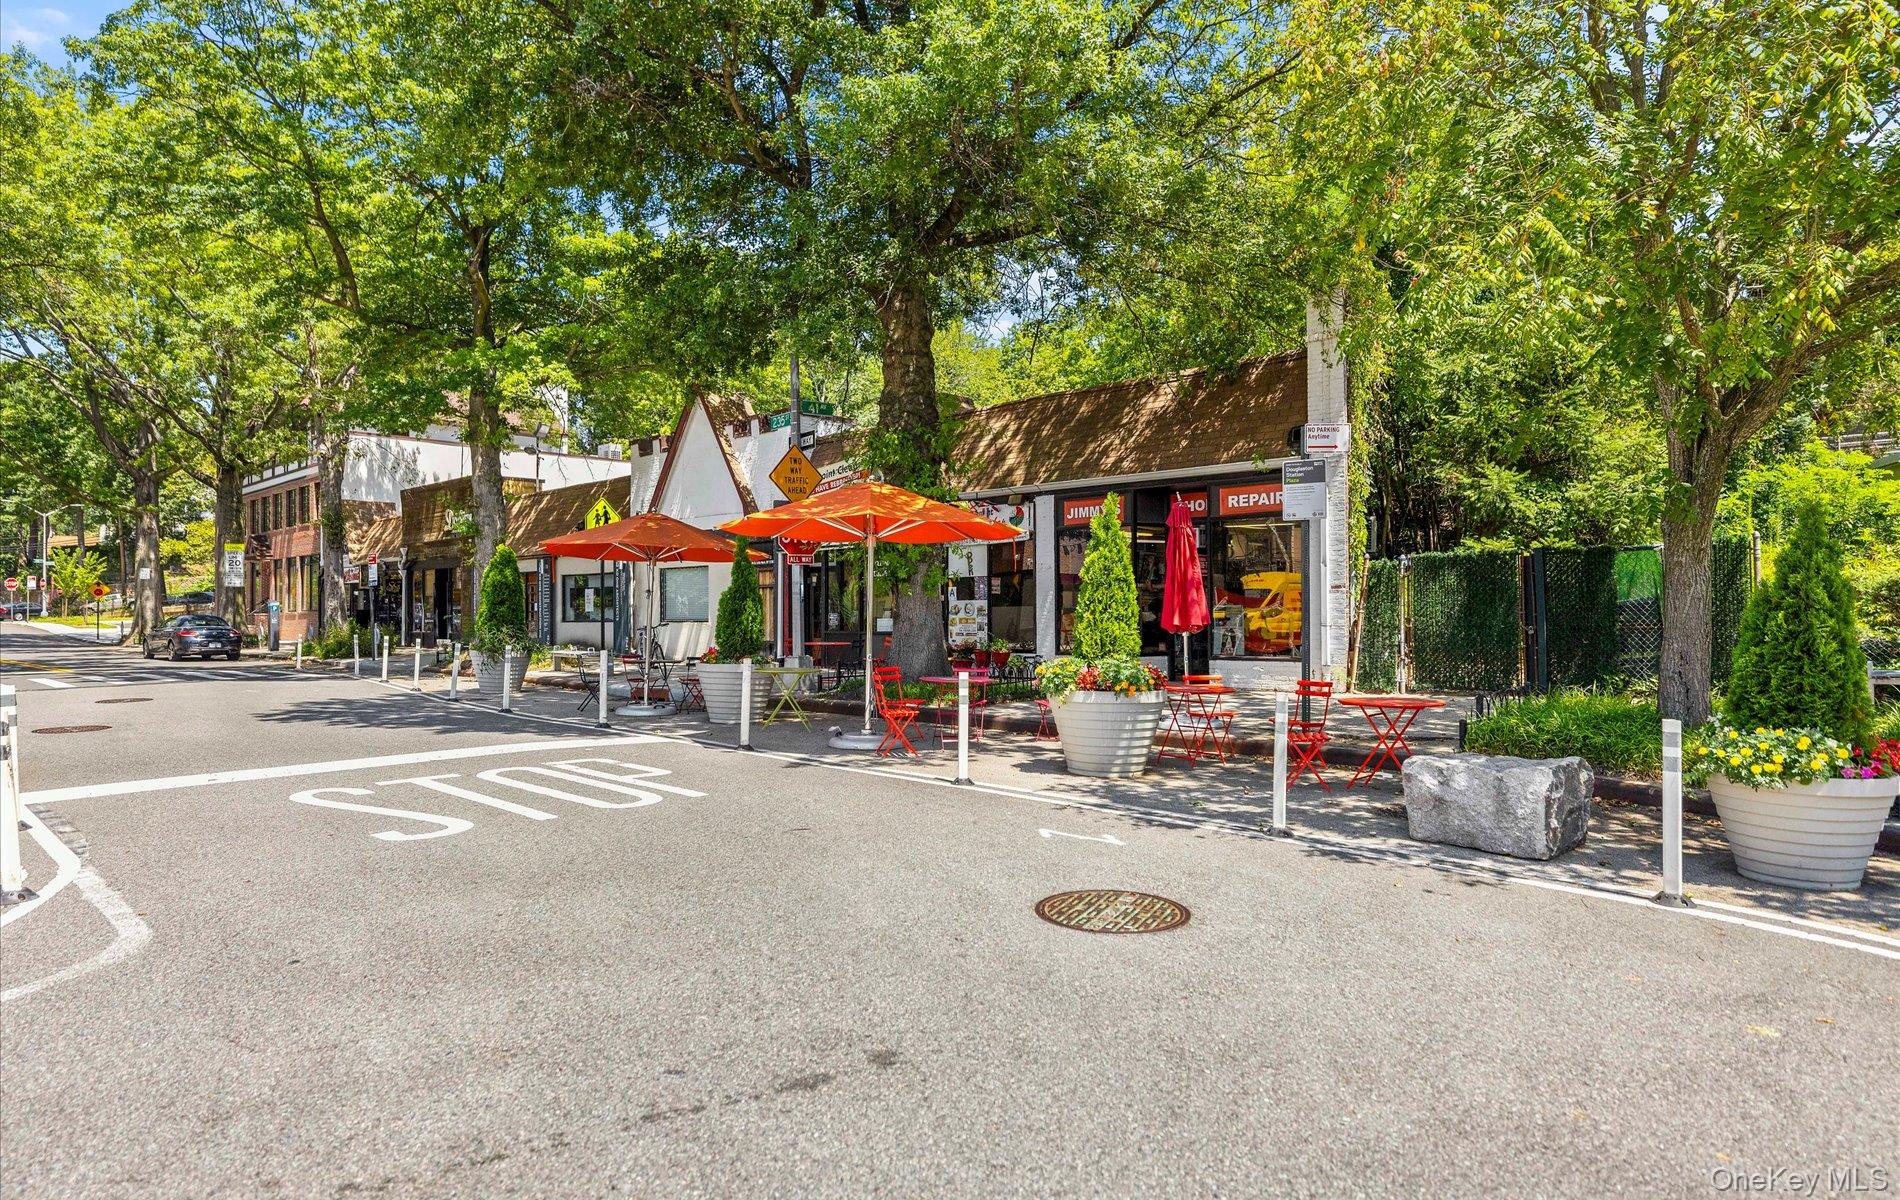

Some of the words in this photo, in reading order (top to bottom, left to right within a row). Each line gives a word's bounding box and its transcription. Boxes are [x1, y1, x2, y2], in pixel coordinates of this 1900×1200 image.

[772, 415, 786, 428] 235
[789, 457, 802, 465] TWO
[790, 467, 802, 475] WAY
[784, 476, 809, 485] TRAFFIC
[787, 486, 807, 495] AHEAD
[815, 482, 830, 492] HAVE
[288, 757, 710, 842] STOP
